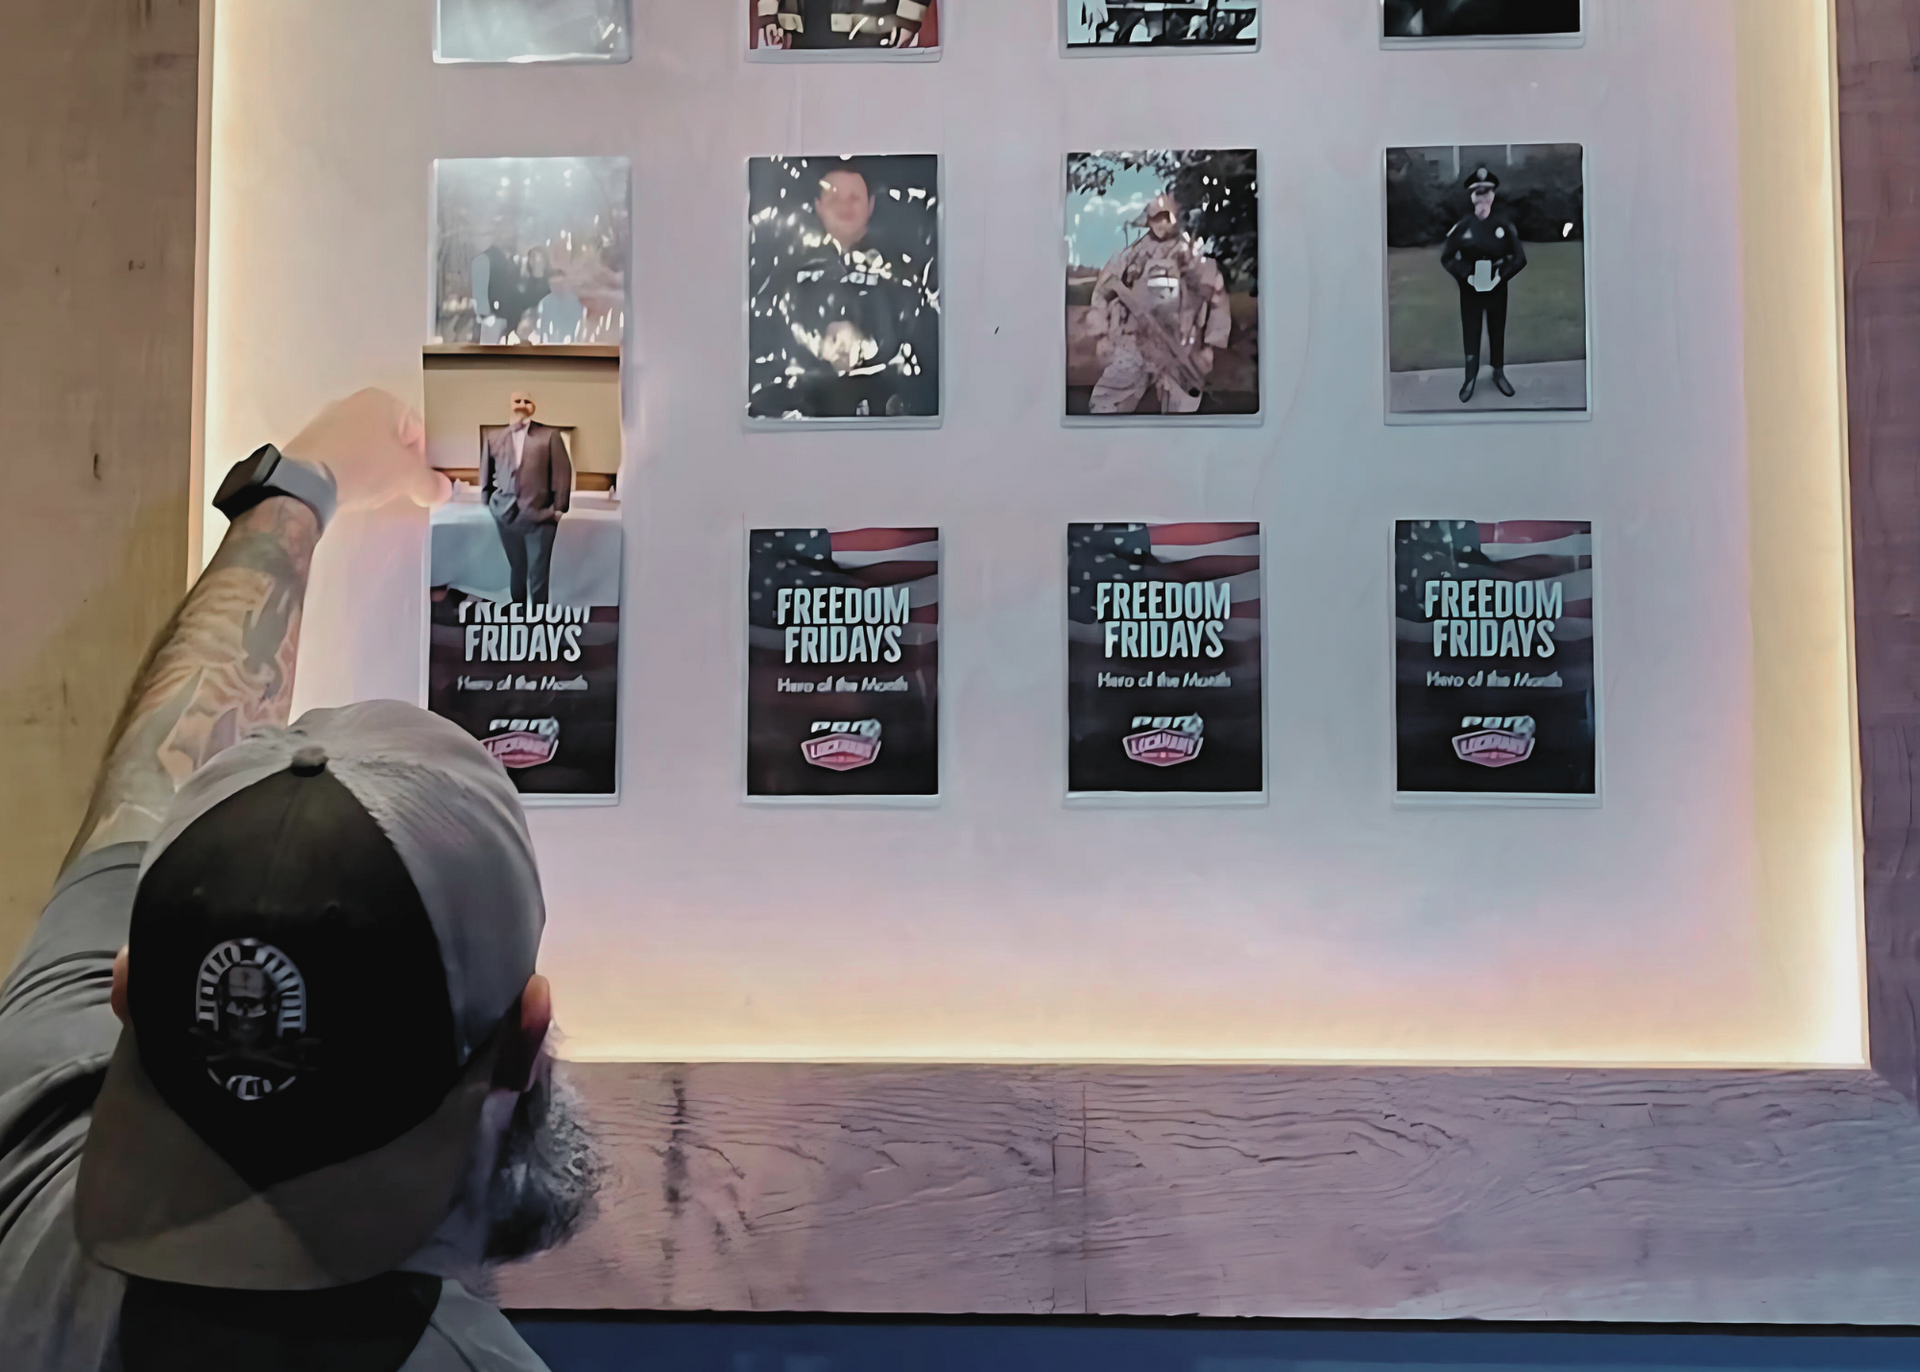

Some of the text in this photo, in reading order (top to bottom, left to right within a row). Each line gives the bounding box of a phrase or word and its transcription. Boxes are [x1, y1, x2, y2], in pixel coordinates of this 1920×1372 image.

[777, 586, 910, 625] FREEDOM
[1096, 581, 1231, 620] FREEDOM
[1424, 579, 1562, 619] FREEDOM
[465, 624, 582, 662] FRIDAYS
[785, 625, 902, 663] FRIDAYS
[1105, 620, 1224, 658] FRIDAYS
[1433, 619, 1555, 658] FRIDAYS
